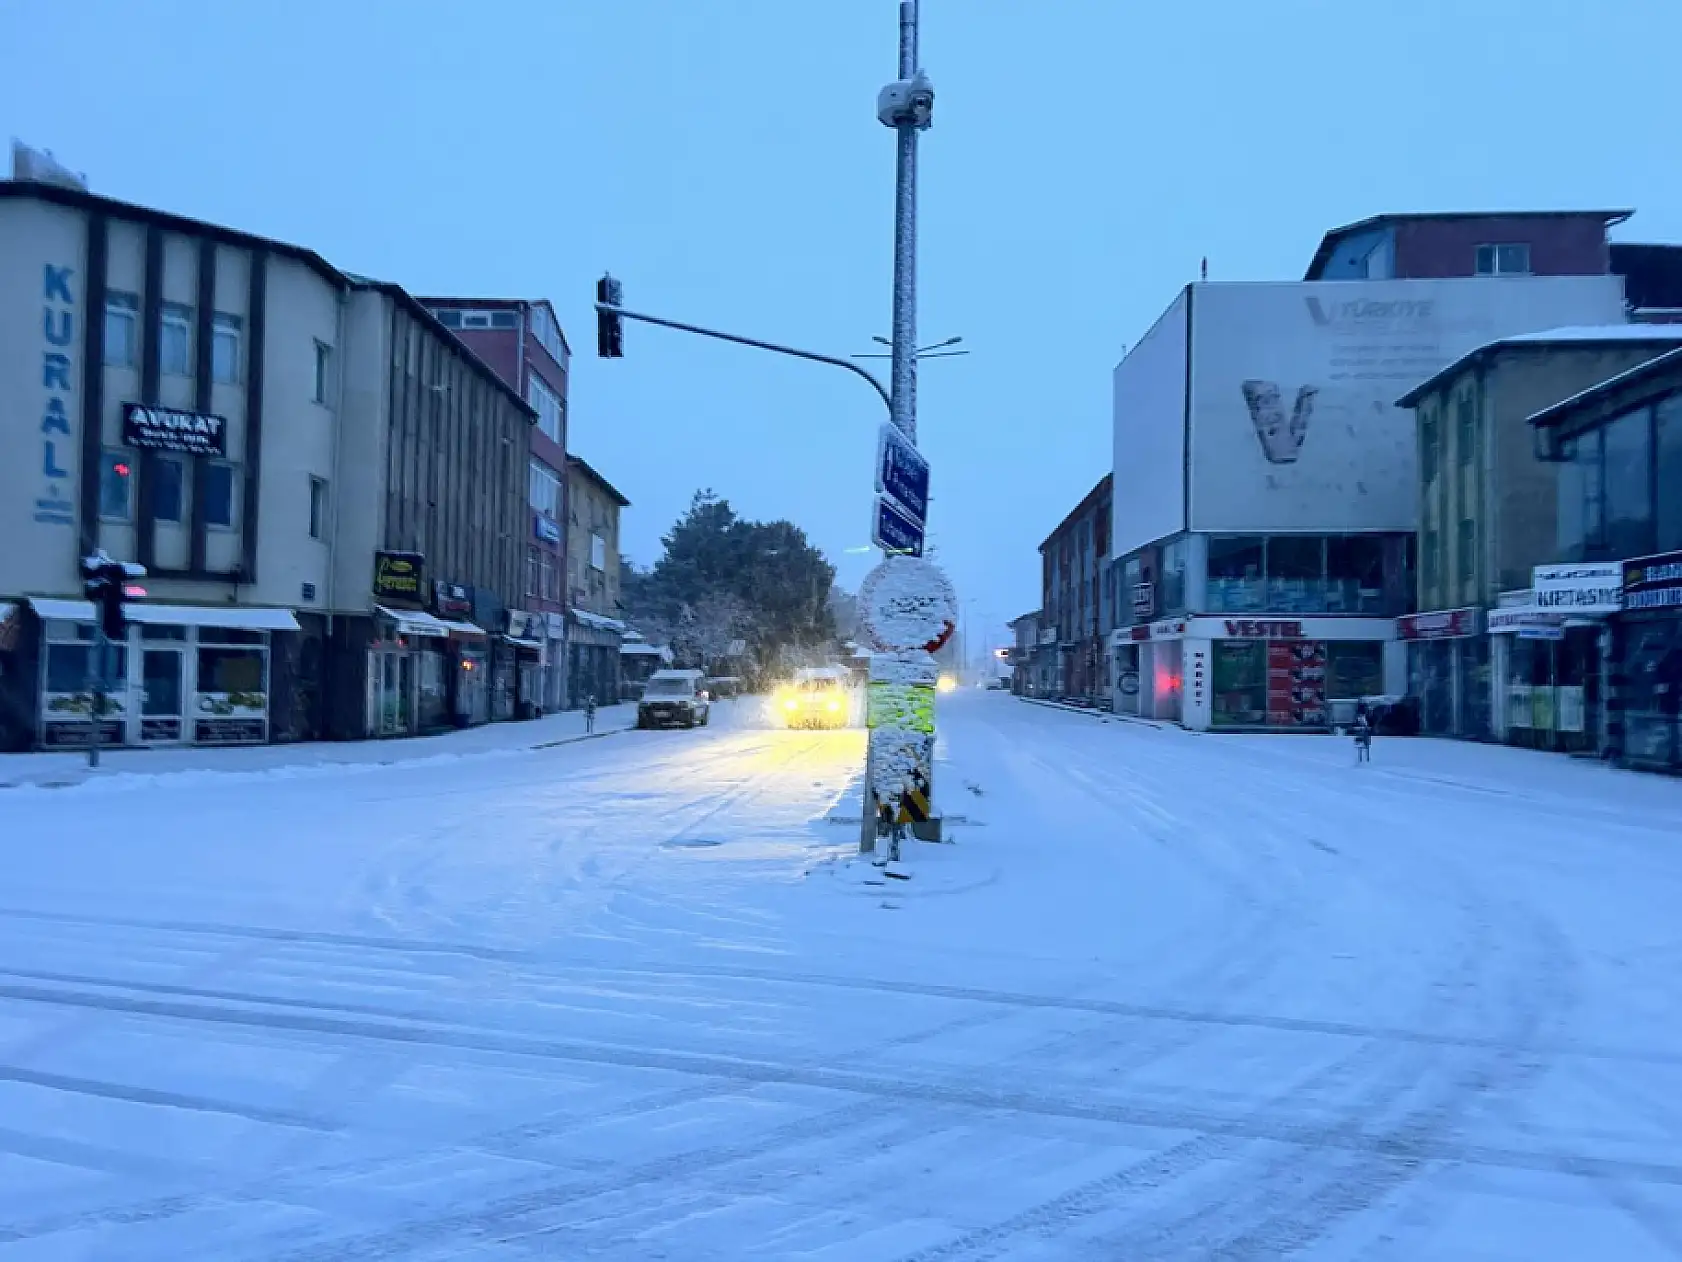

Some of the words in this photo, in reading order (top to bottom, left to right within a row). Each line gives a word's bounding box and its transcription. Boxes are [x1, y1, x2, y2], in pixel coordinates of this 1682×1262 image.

[43, 263, 74, 478] KURAL
[130, 407, 221, 434] AVUKAT
[1224, 619, 1304, 638] VESTEL
[1194, 652, 1204, 706] MARKET
